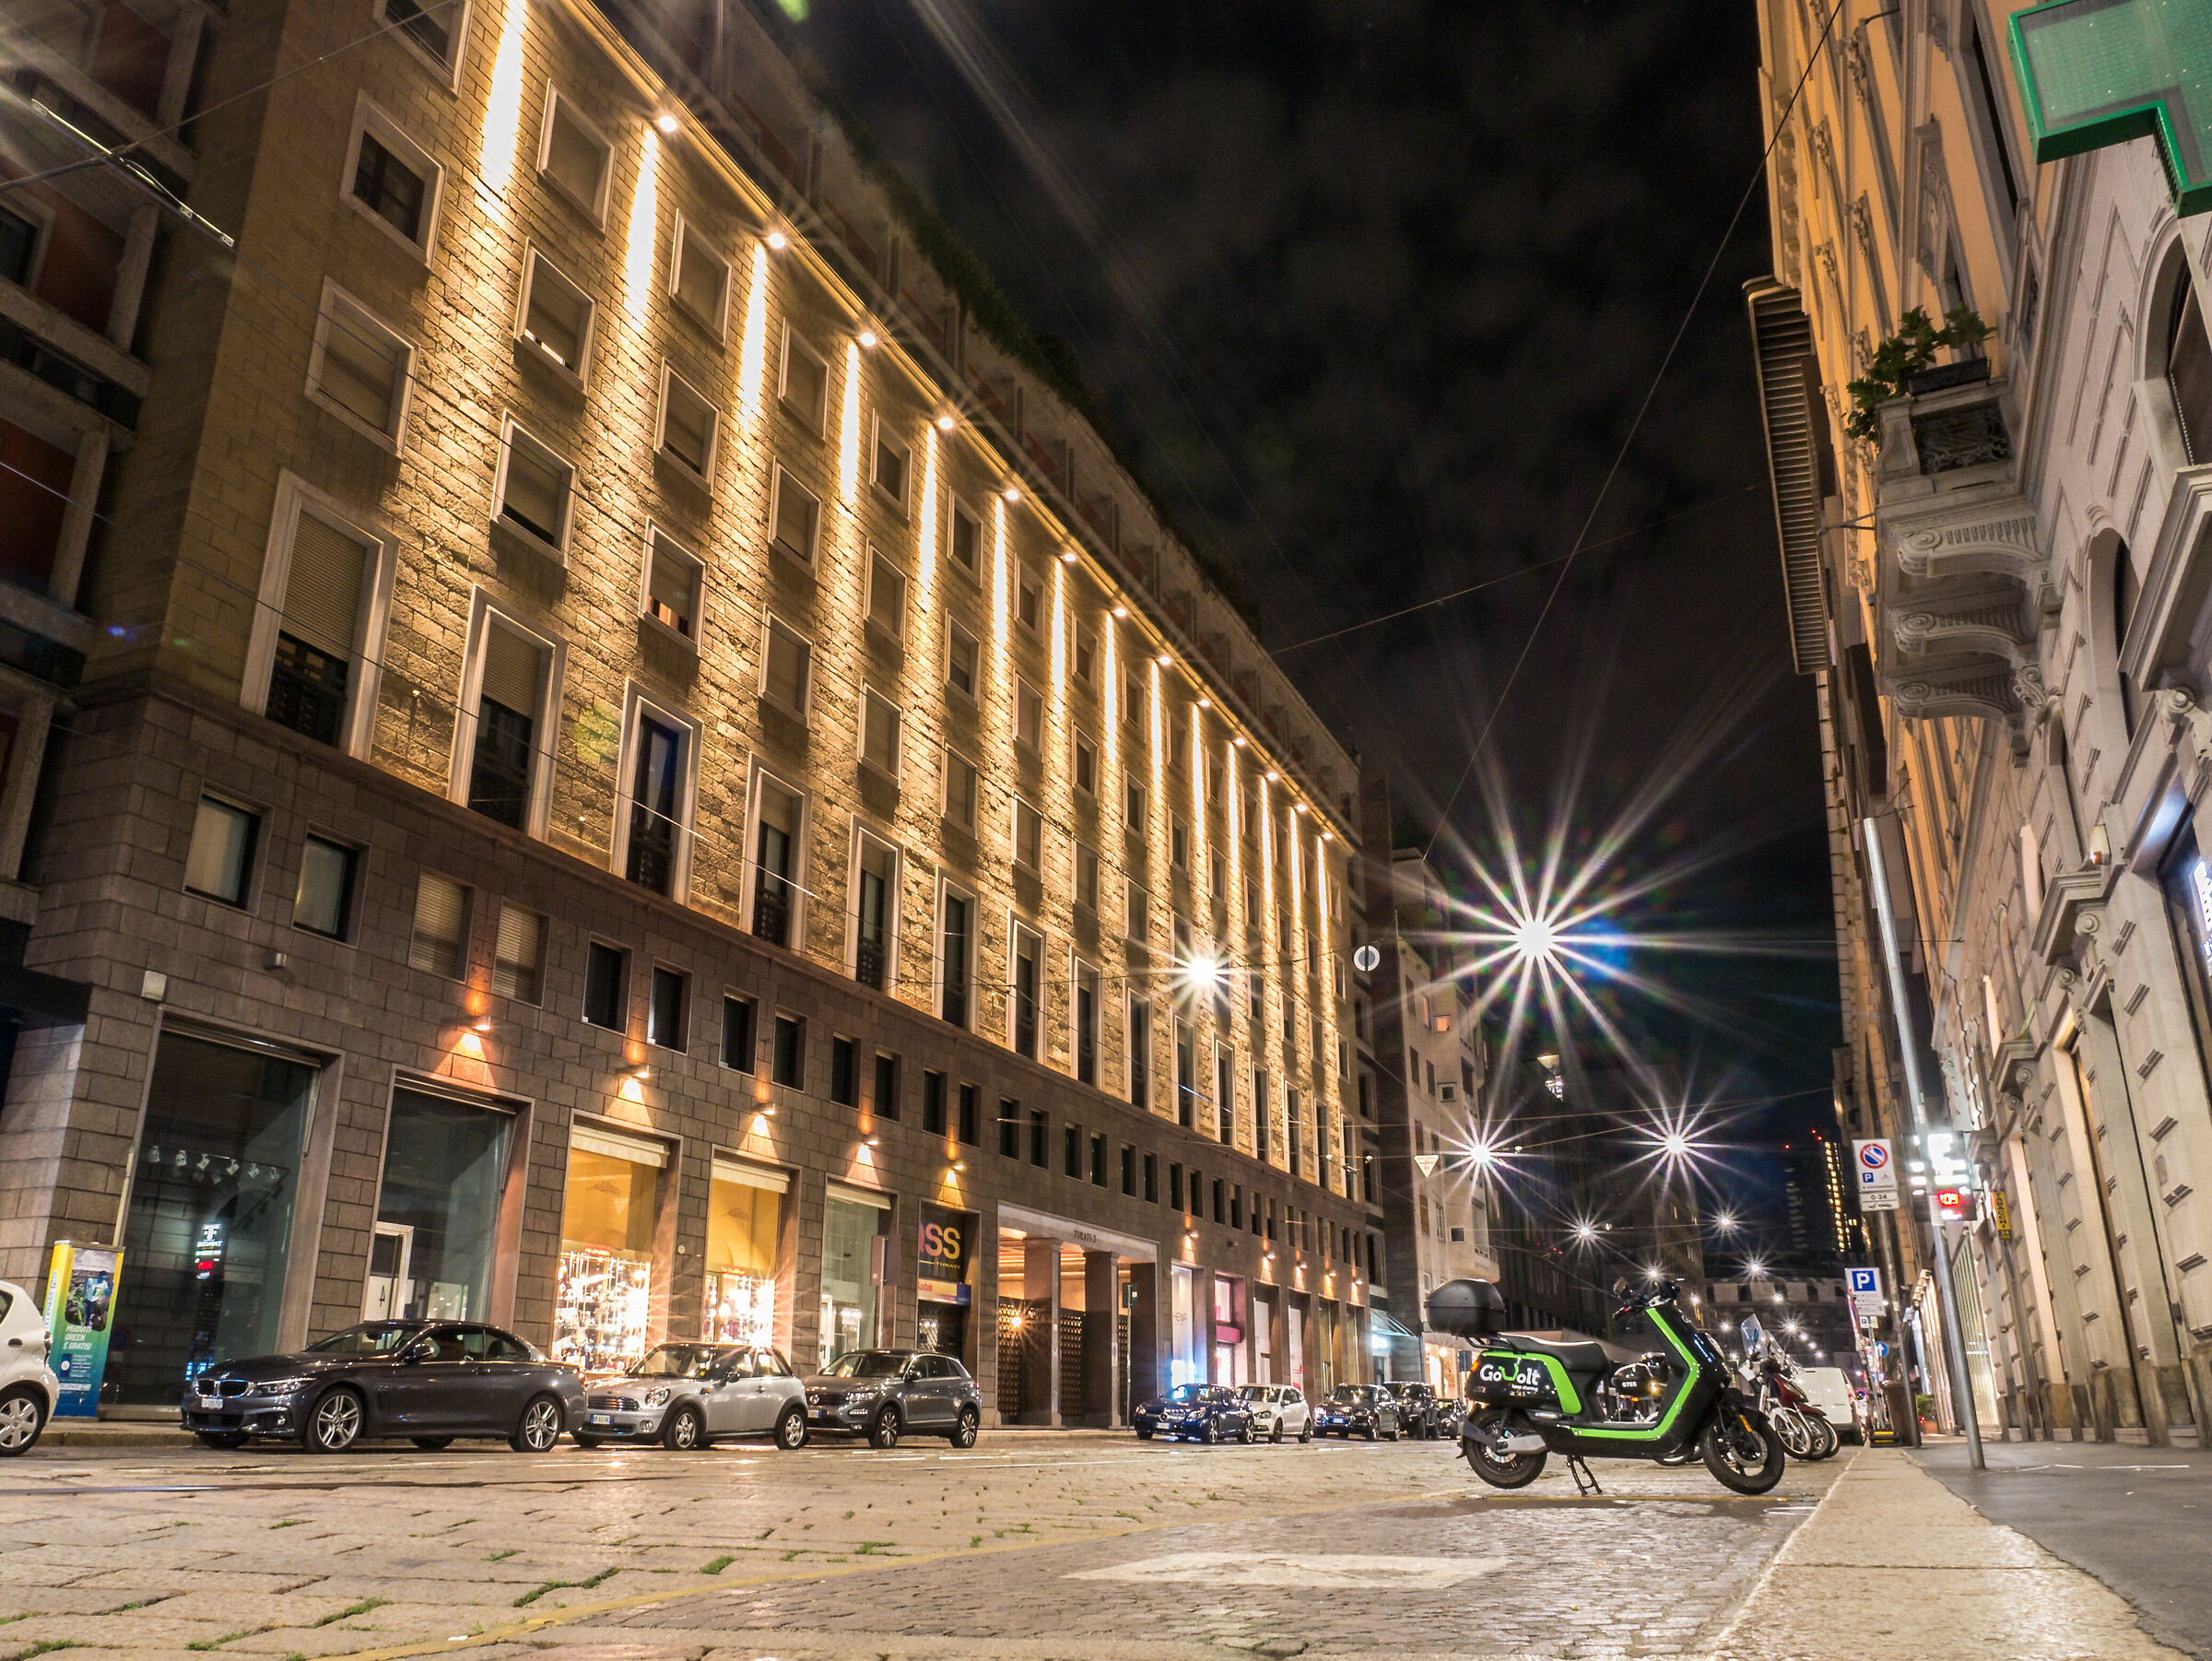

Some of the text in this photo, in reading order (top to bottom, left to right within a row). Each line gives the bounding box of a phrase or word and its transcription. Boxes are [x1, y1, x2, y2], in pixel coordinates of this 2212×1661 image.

[1995, 1193, 2007, 1229] TABACCHI
[1856, 1272, 1870, 1290] P
[63, 1341, 68, 1349] E
[65, 1333, 87, 1341] GREEN
[1480, 1363, 1540, 1385] GoVolt
